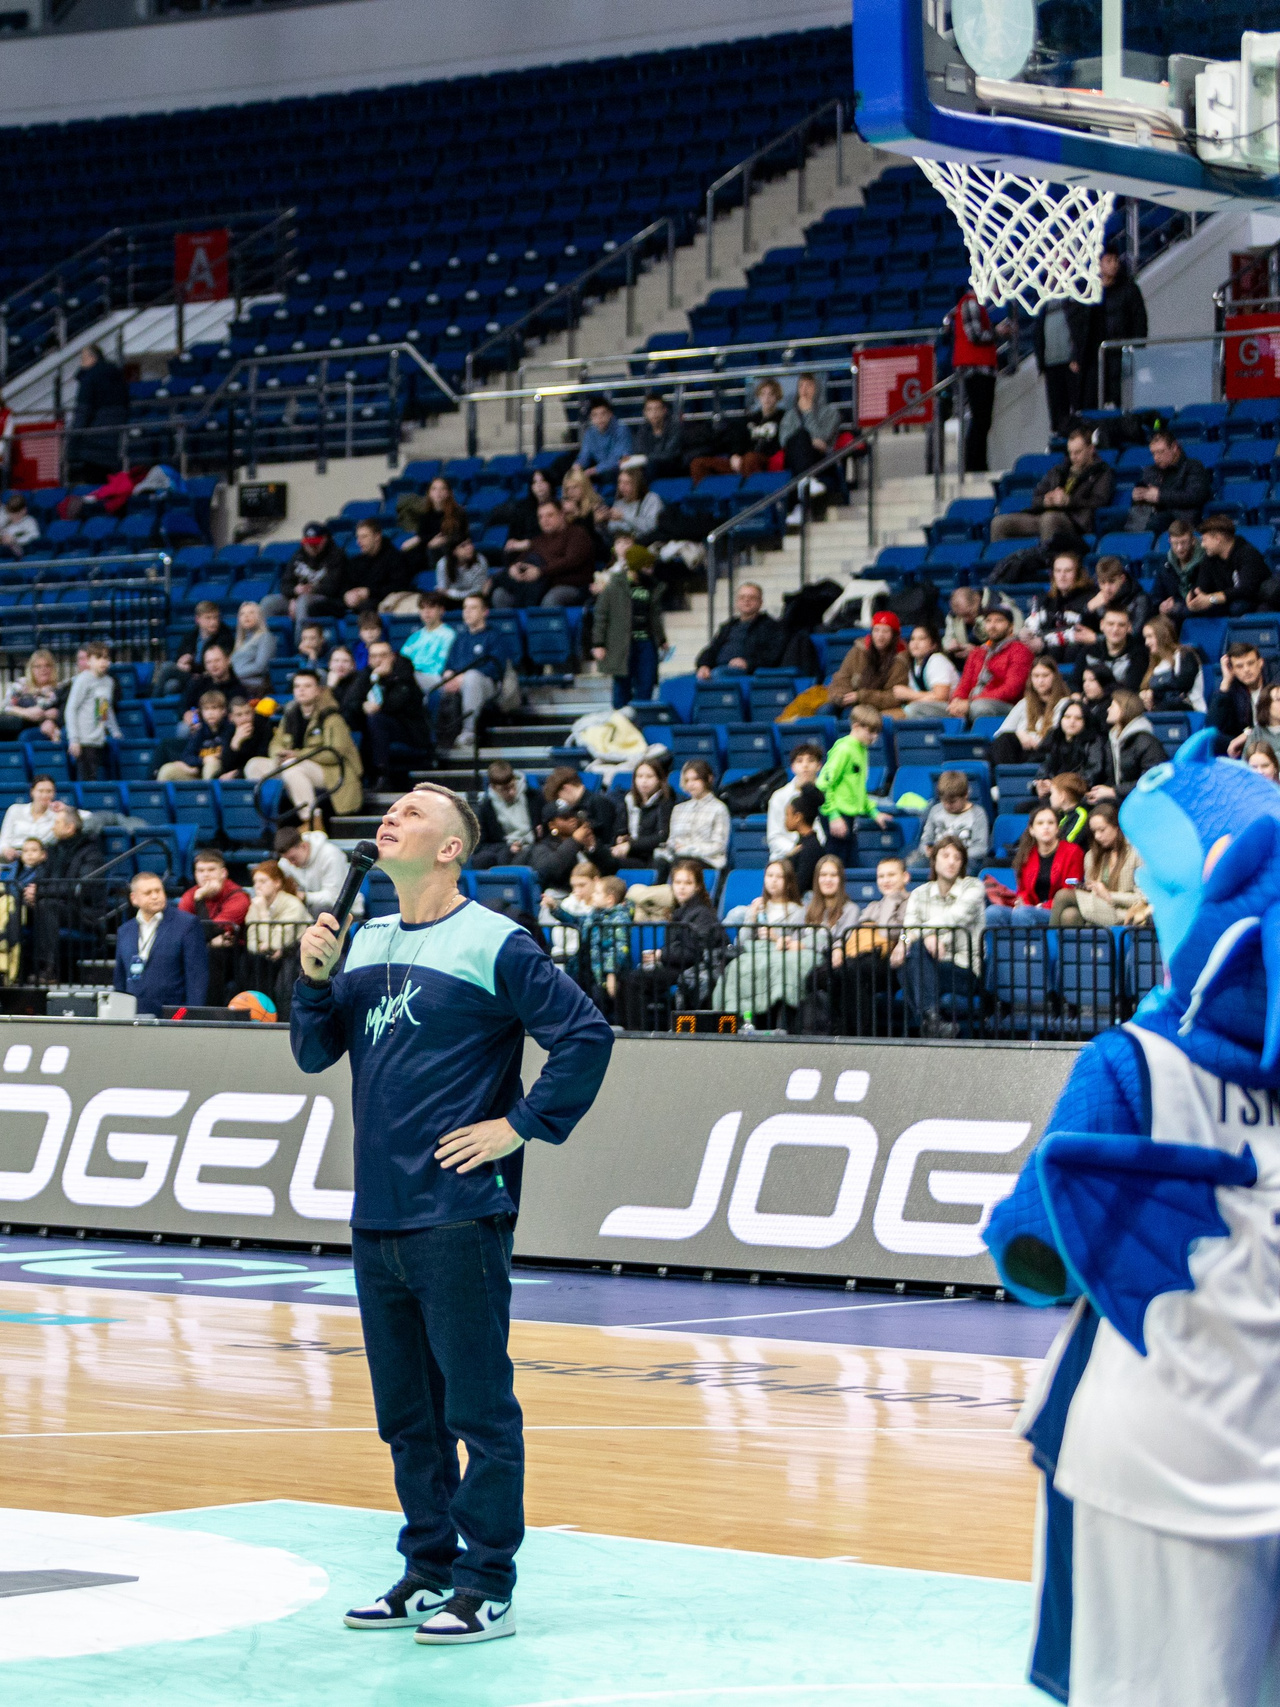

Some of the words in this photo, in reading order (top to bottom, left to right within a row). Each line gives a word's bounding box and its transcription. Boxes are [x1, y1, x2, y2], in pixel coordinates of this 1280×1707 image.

[185, 246, 215, 291] A
[1238, 338, 1260, 367] G
[599, 1068, 1032, 1257] JÖG
